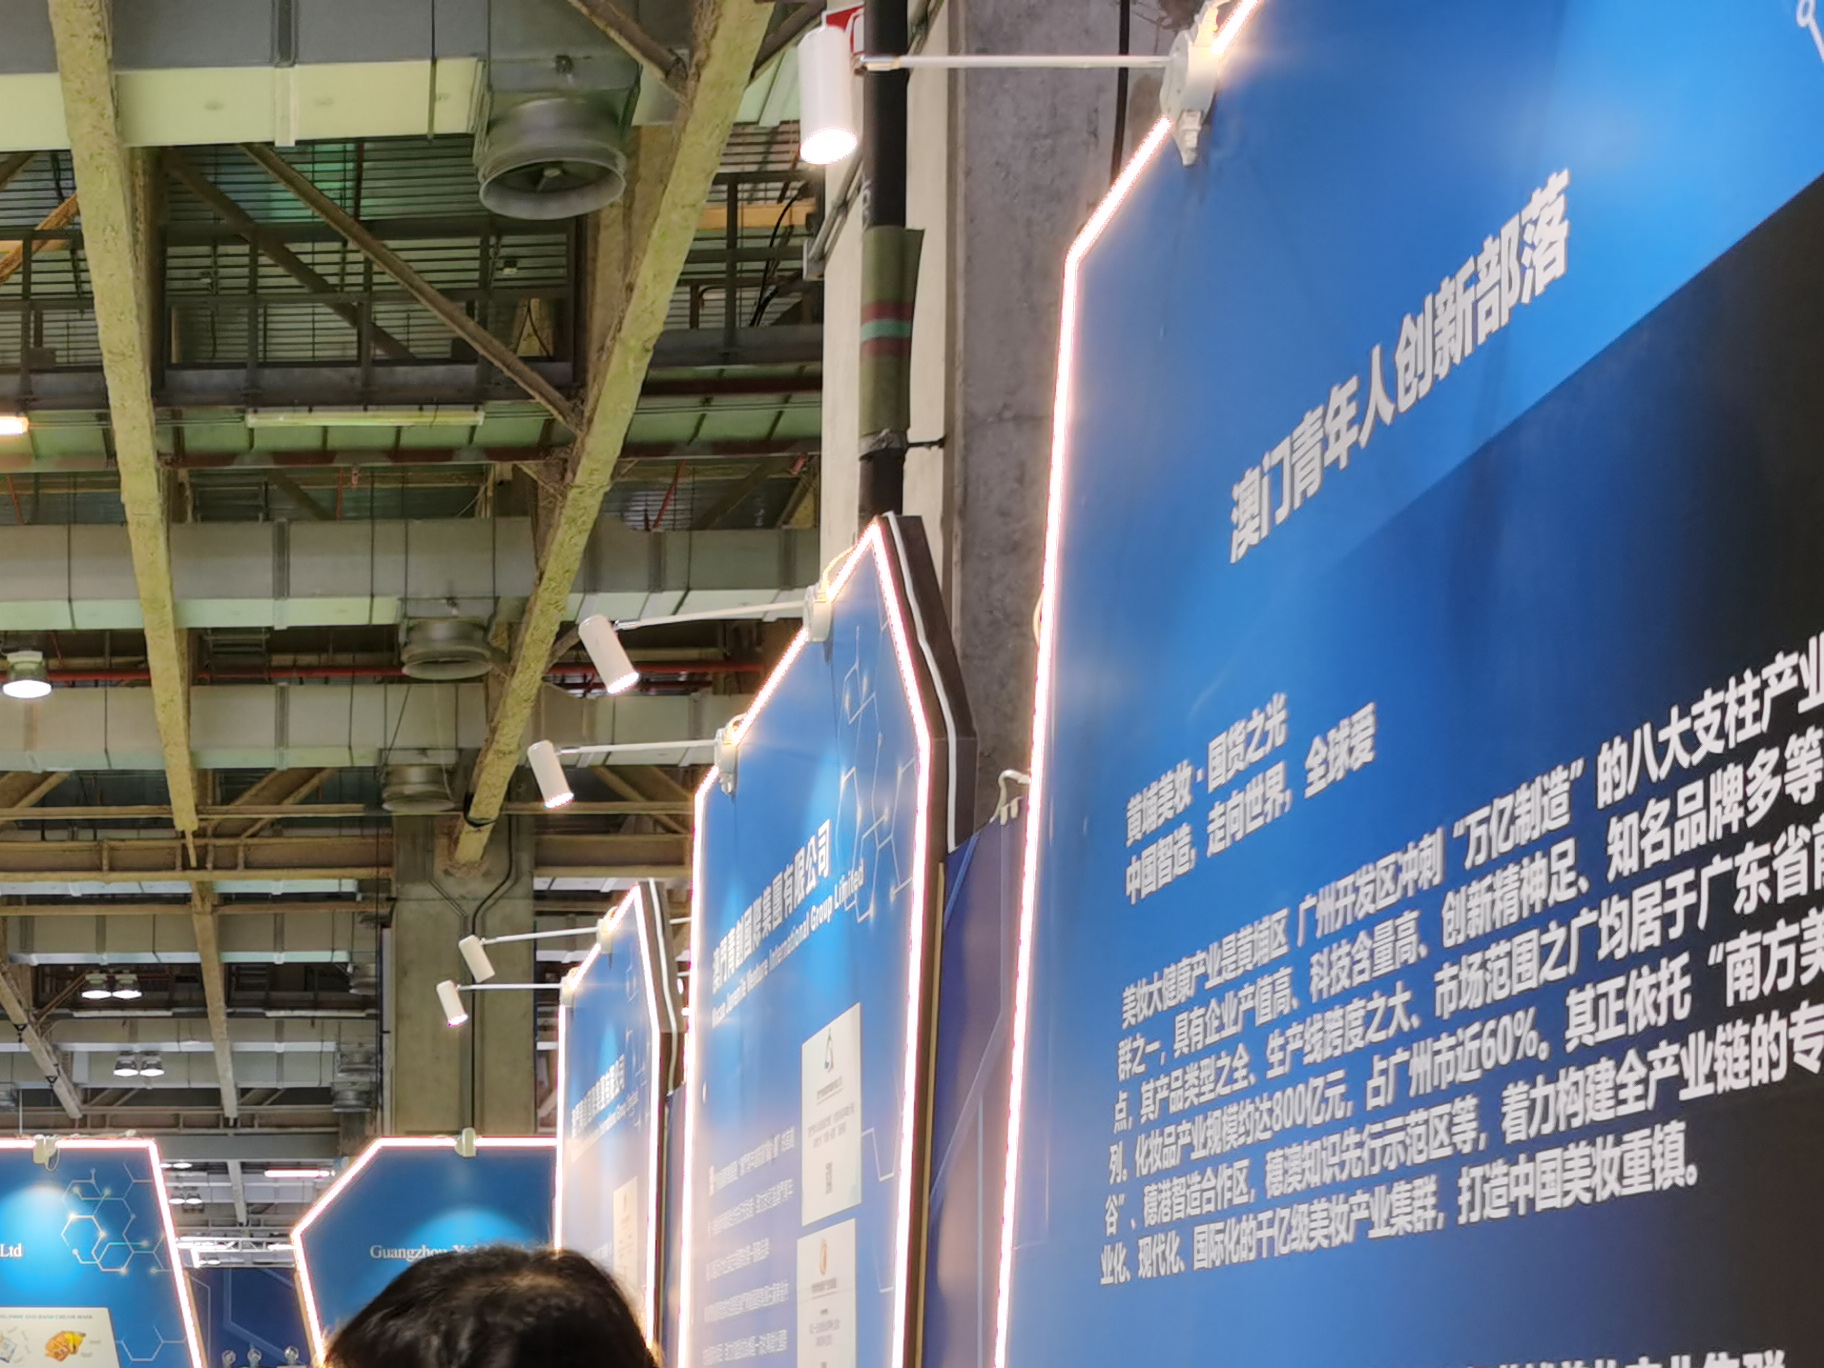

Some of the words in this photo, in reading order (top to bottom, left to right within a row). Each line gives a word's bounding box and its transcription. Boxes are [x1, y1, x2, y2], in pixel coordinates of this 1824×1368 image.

[1229, 168, 1572, 564] 澳门青年人创新部落
[811, 900, 833, 934] Group
